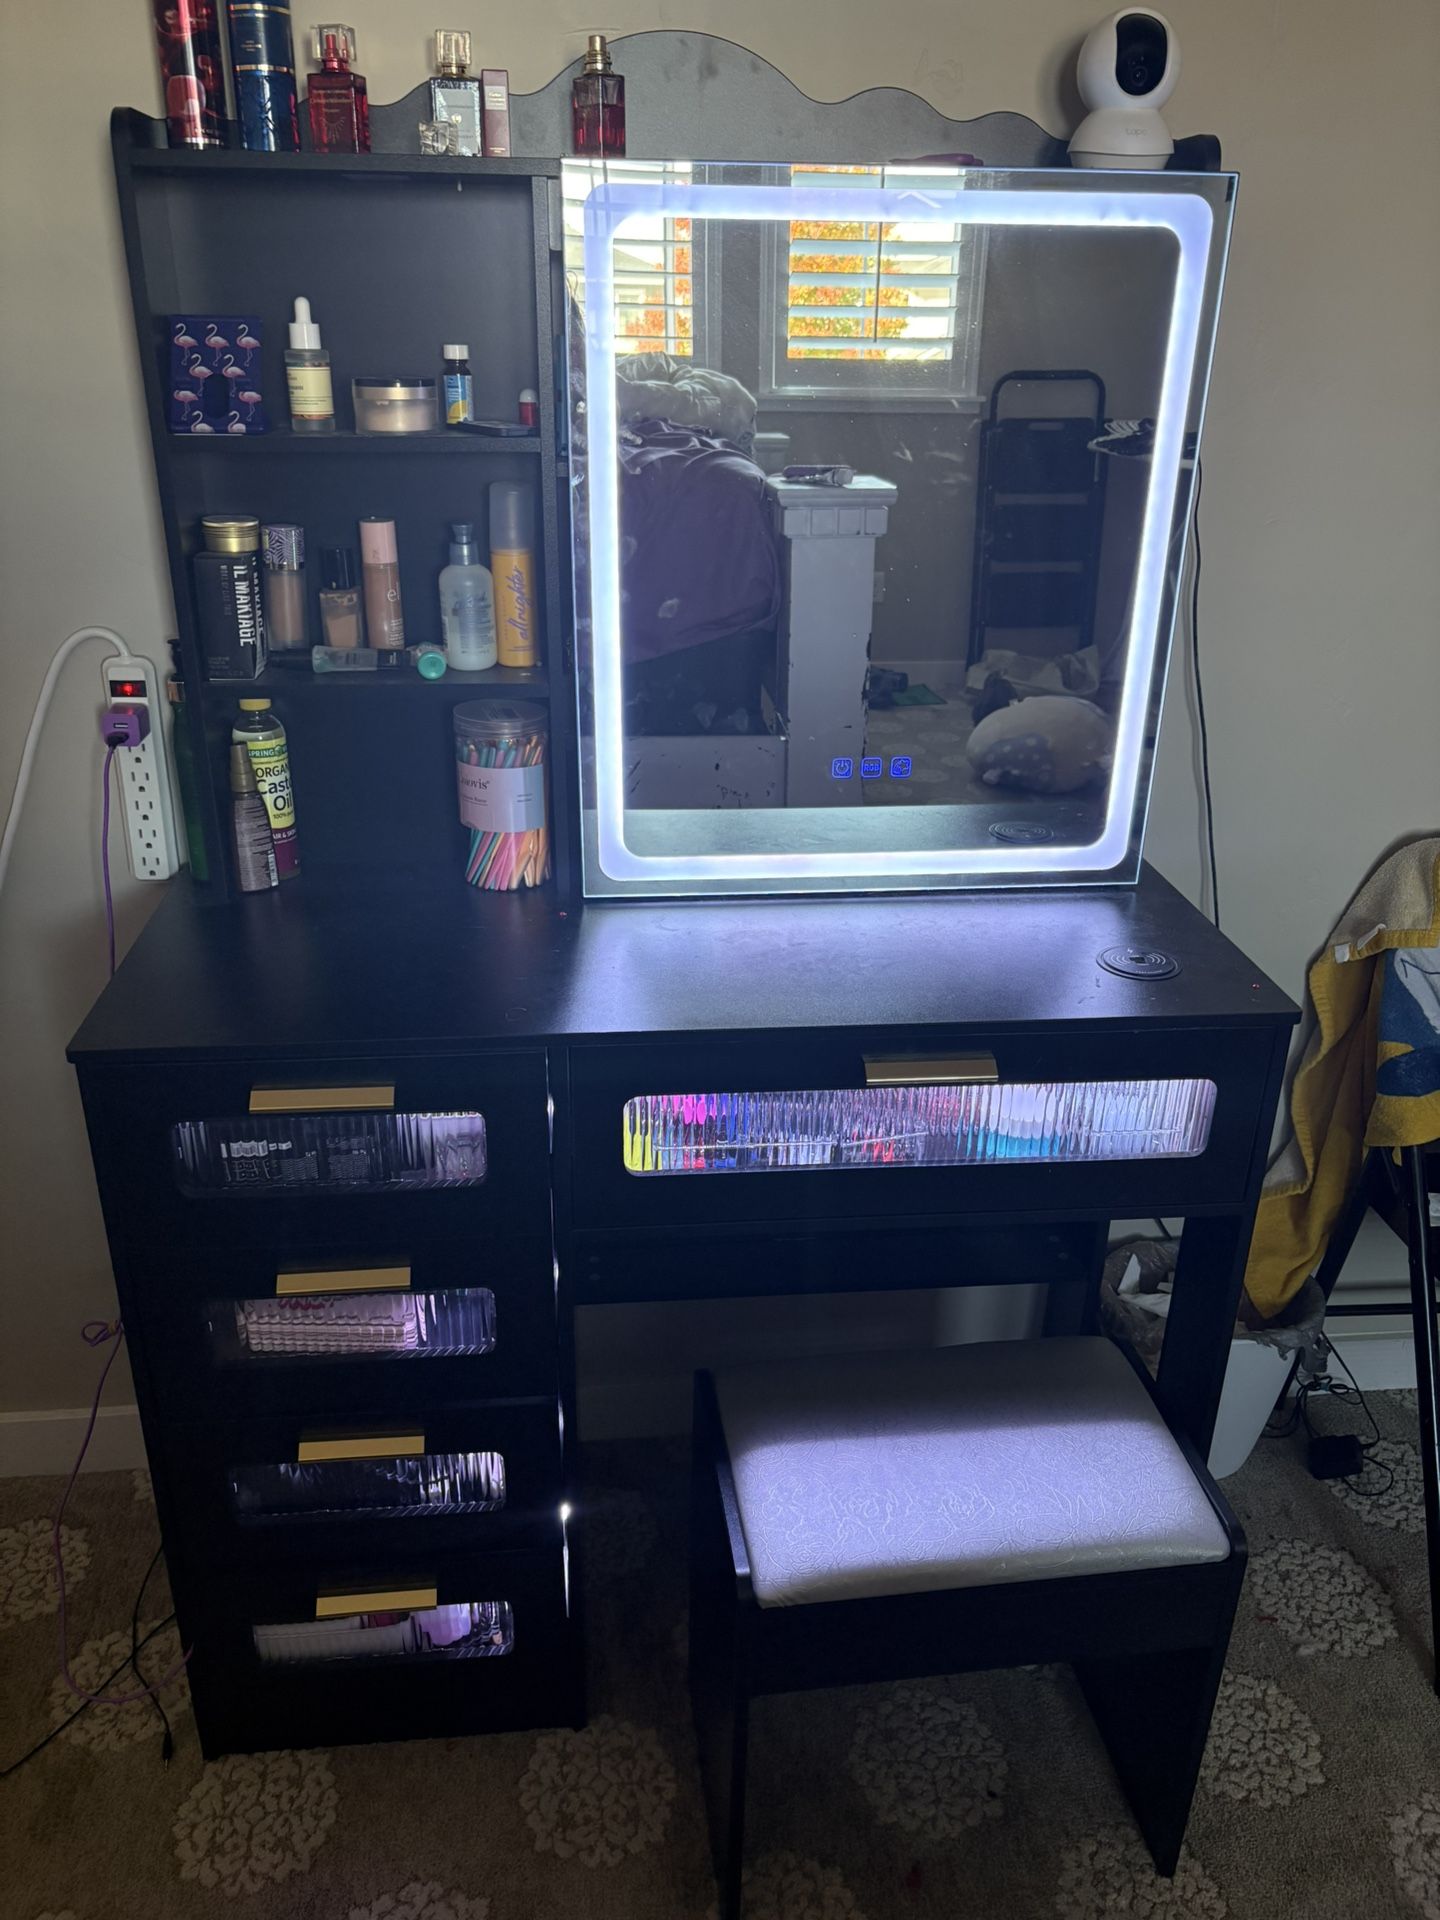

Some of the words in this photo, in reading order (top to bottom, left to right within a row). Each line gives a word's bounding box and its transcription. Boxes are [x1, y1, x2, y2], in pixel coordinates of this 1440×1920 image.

[232, 565, 248, 579] IL
[234, 580, 256, 647] MAKIAGE
[863, 763, 879, 772] RGB
[273, 794, 293, 811] Oil
